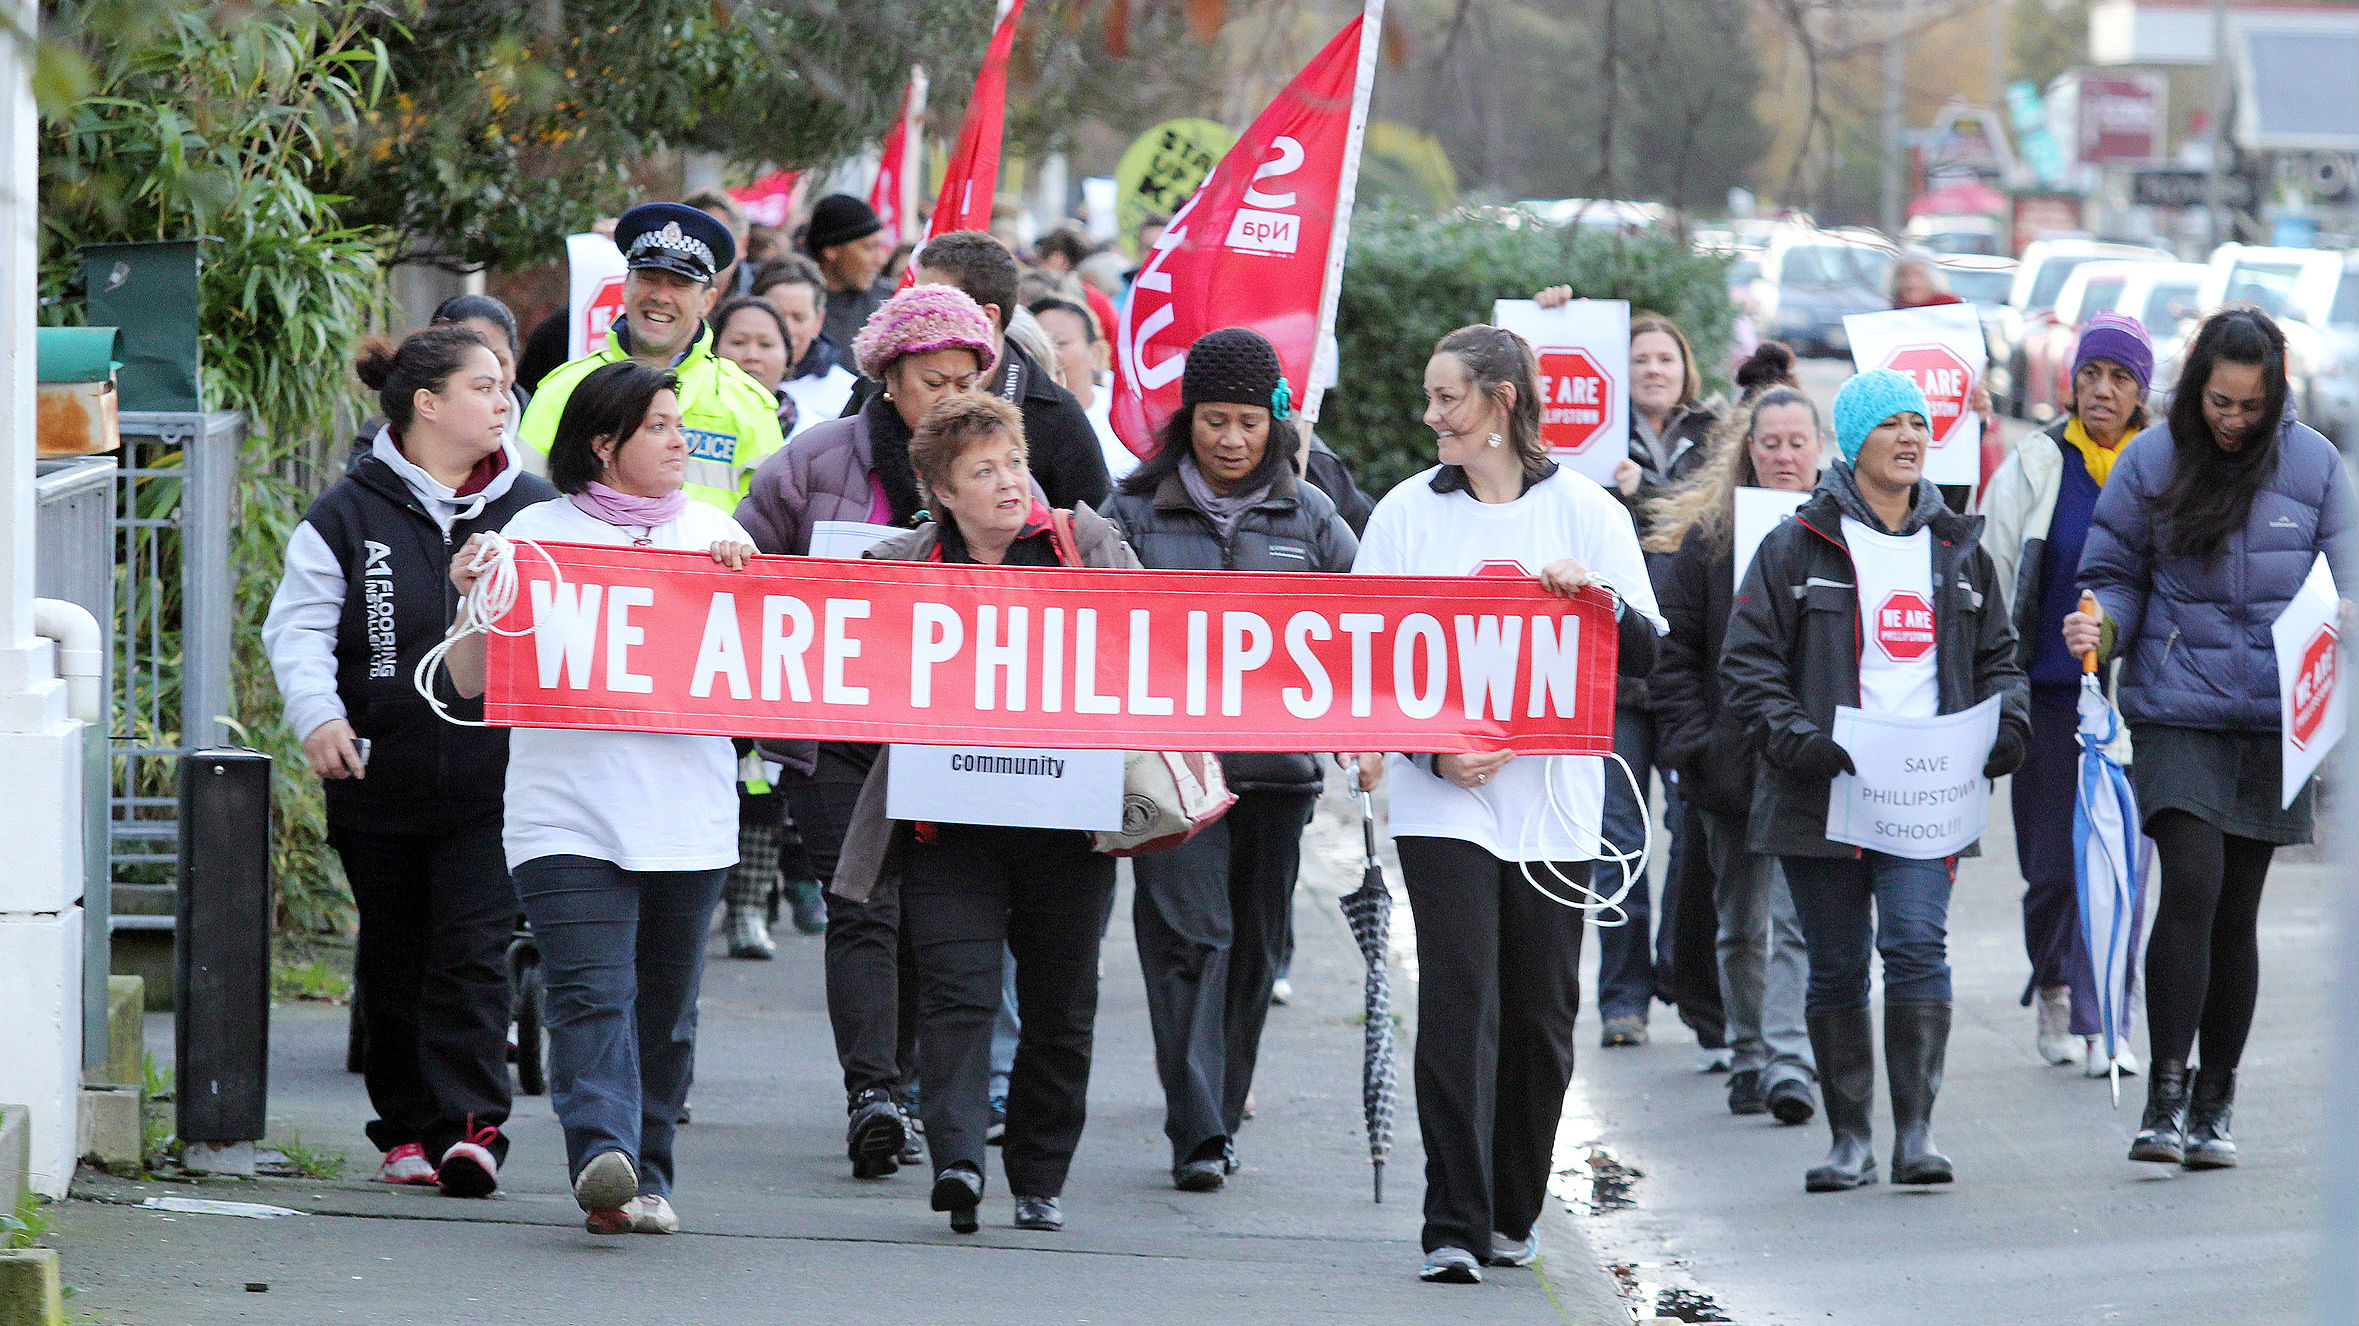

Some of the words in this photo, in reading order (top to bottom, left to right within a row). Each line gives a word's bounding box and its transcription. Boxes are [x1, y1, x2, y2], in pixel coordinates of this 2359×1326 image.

[1536, 375, 1553, 404] E
[1556, 375, 1600, 405] ARE
[1924, 368, 1963, 397] ARE
[684, 432, 737, 459] OLICE
[364, 539, 393, 577] A1
[375, 579, 398, 677] FLOORING
[1882, 608, 1904, 628] WE
[1904, 608, 1933, 630] ARE
[530, 579, 654, 694] WE
[689, 591, 872, 706] ARE
[909, 600, 1581, 722] PHILLIPSTOWN
[951, 753, 1065, 779] community
[1903, 755, 1950, 774] SAVE
[1862, 779, 1977, 807] PHILLIPSTOWN
[1874, 816, 1963, 840] SCHOOL!!!
